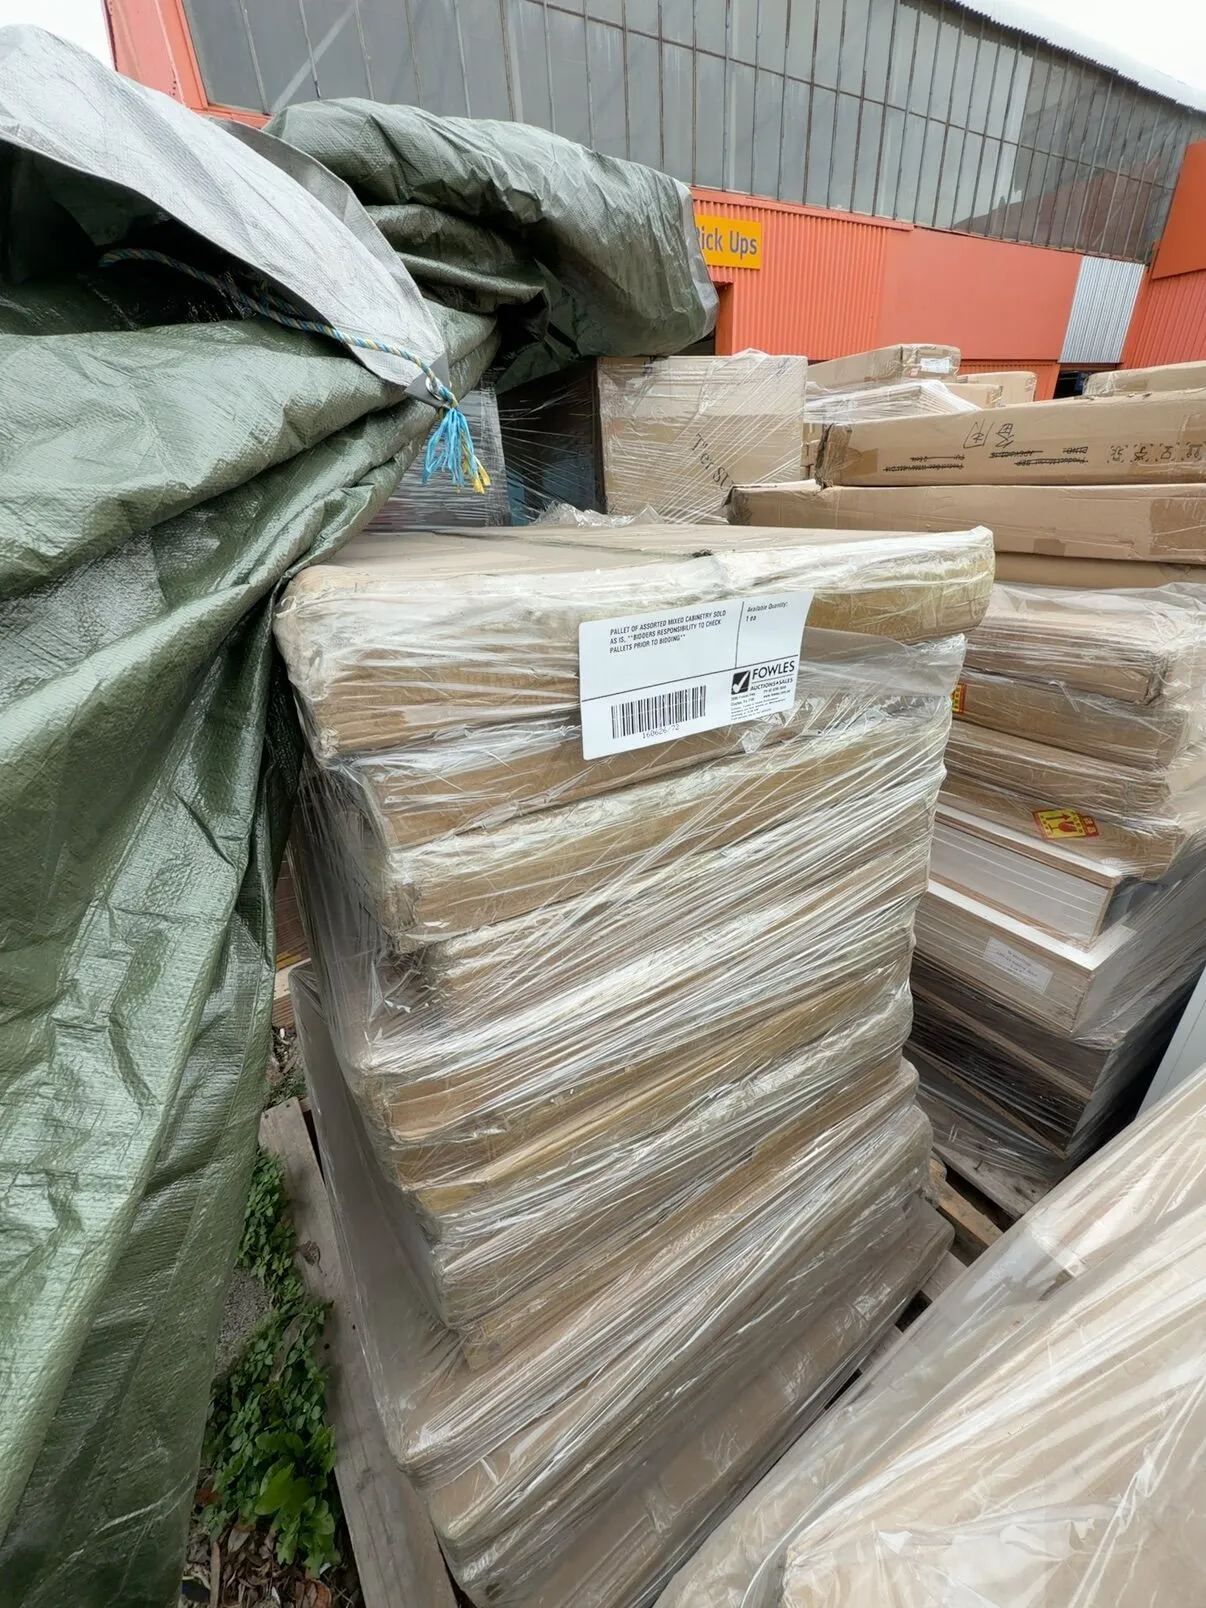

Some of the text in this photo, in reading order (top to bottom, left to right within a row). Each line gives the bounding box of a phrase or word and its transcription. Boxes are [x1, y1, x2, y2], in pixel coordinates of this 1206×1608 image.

[729, 230, 758, 260] Ups
[747, 604, 768, 613] Available
[609, 626, 630, 636] PALLET
[640, 619, 667, 631] ASSORTED
[667, 617, 685, 626] MIXED
[685, 612, 713, 623] CABINETRY
[713, 609, 727, 618] SOLD
[609, 637, 618, 645] AS
[656, 623, 697, 636] RESPONSIBILITY
[698, 621, 705, 629] TO
[705, 619, 722, 628] CHECK
[609, 644, 633, 654] PALLETS
[633, 640, 650, 649] PRIOR
[651, 638, 659, 646] TO
[752, 660, 795, 680] FOWLES
